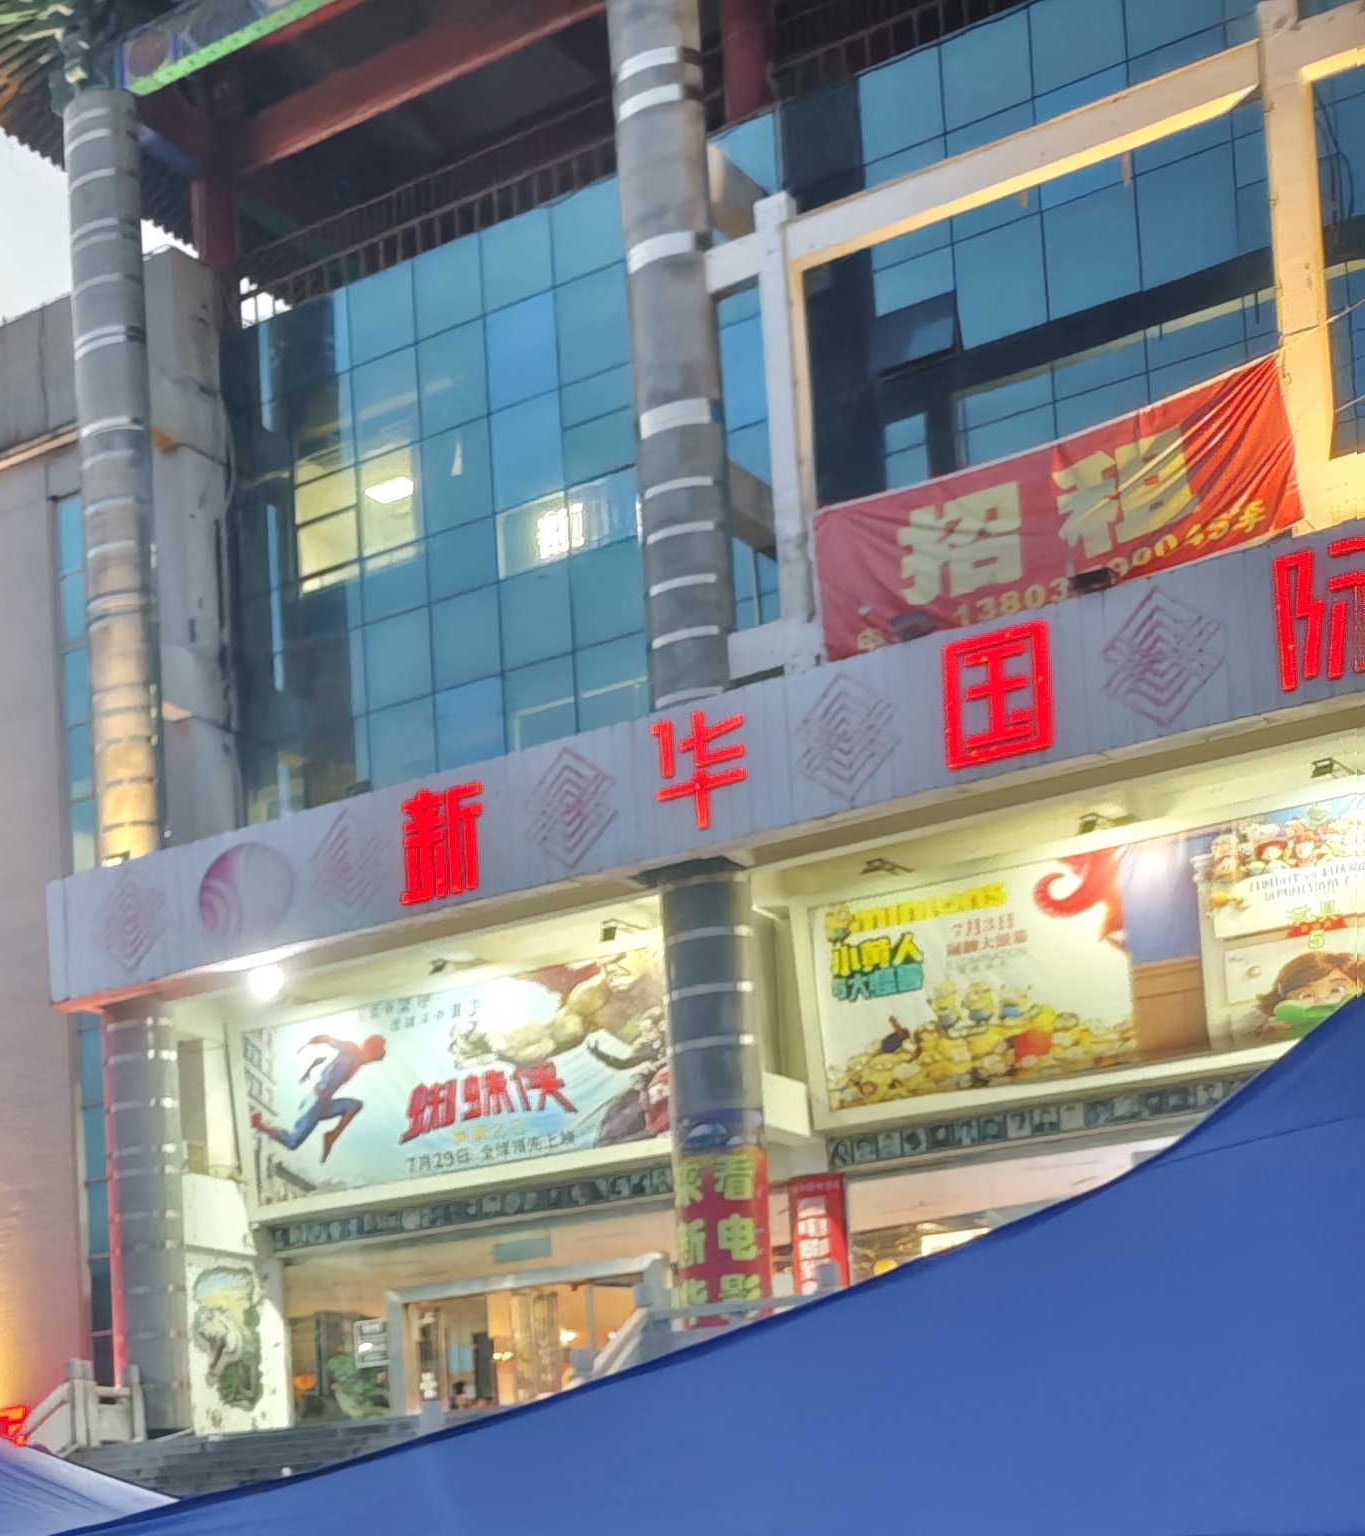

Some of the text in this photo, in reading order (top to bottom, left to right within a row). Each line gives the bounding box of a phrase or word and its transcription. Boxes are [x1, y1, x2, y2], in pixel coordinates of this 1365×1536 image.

[898, 424, 1199, 607] 招租
[398, 1061, 579, 1145] 蜘蛛侠
[406, 1147, 473, 1174] 7月29日
